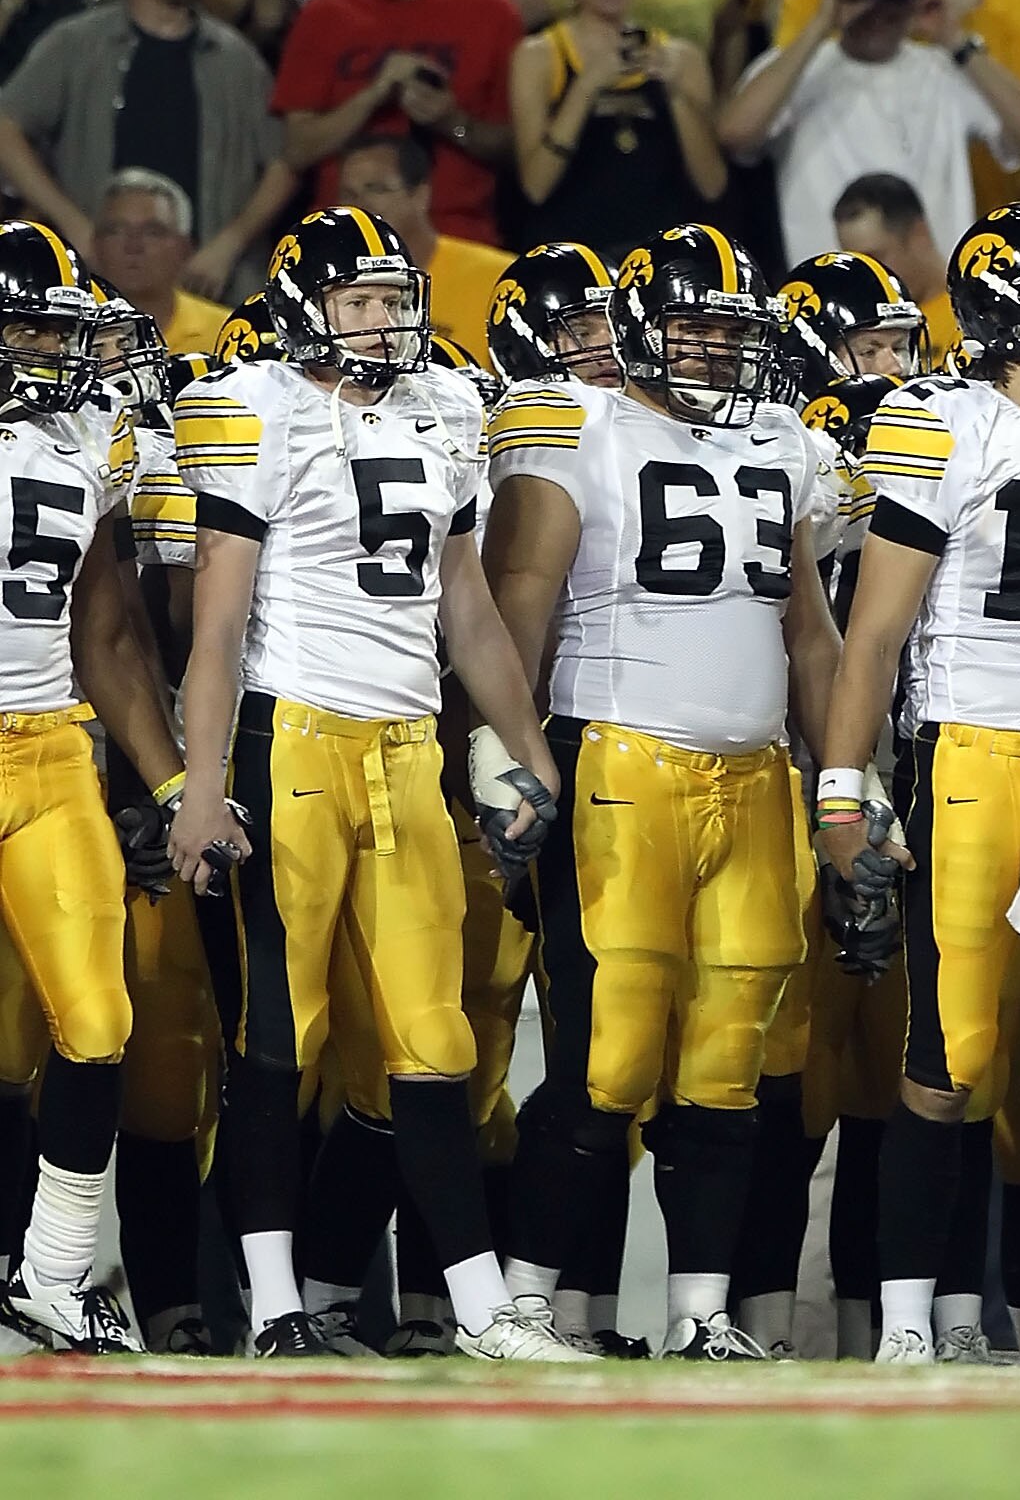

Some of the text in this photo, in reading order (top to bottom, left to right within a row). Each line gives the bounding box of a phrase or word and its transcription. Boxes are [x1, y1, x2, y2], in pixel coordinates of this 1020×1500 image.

[2, 476, 86, 622] 5
[350, 457, 432, 597] 5
[634, 459, 794, 600] 63
